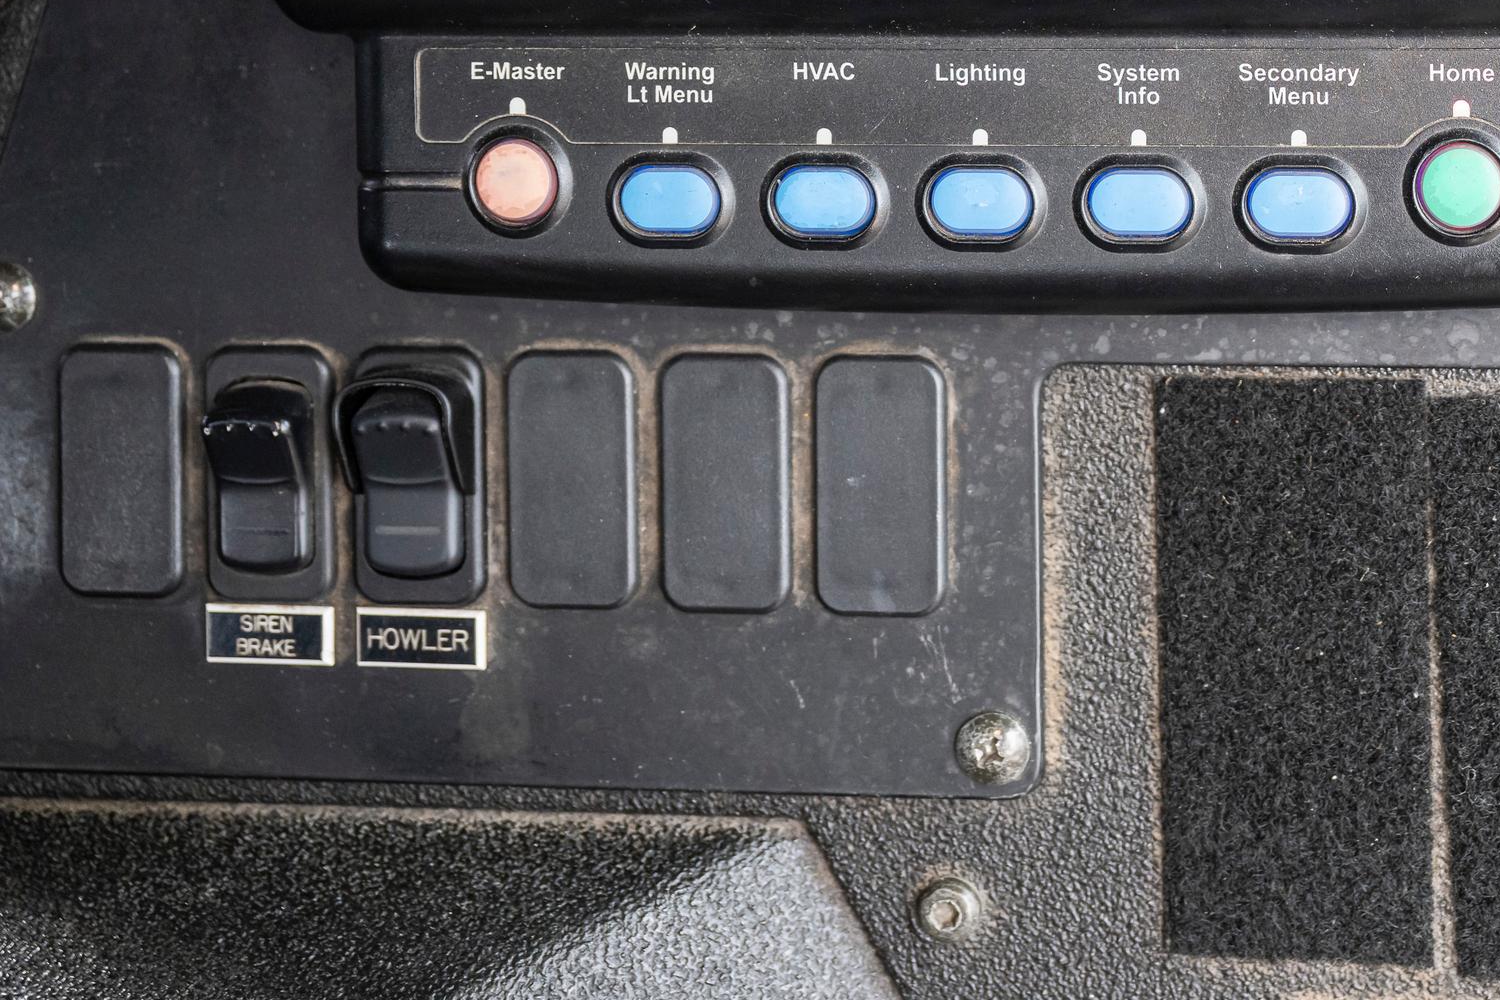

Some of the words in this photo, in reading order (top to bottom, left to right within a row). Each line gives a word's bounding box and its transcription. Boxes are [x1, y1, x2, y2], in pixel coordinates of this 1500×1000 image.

[470, 62, 565, 81] E-Master
[625, 62, 715, 84] Warning
[793, 62, 855, 81] HVAC
[935, 63, 1025, 86] Lighting
[1097, 63, 1180, 86] System
[1239, 64, 1360, 86] Secondary
[1429, 64, 1495, 83] Home
[627, 85, 648, 103] Lt
[655, 86, 713, 103] Menu
[1118, 86, 1160, 105] Info
[1269, 87, 1329, 105] Menu
[239, 615, 293, 634] SIREN
[236, 639, 296, 657] BRAKE
[367, 628, 469, 651] HOWLER
